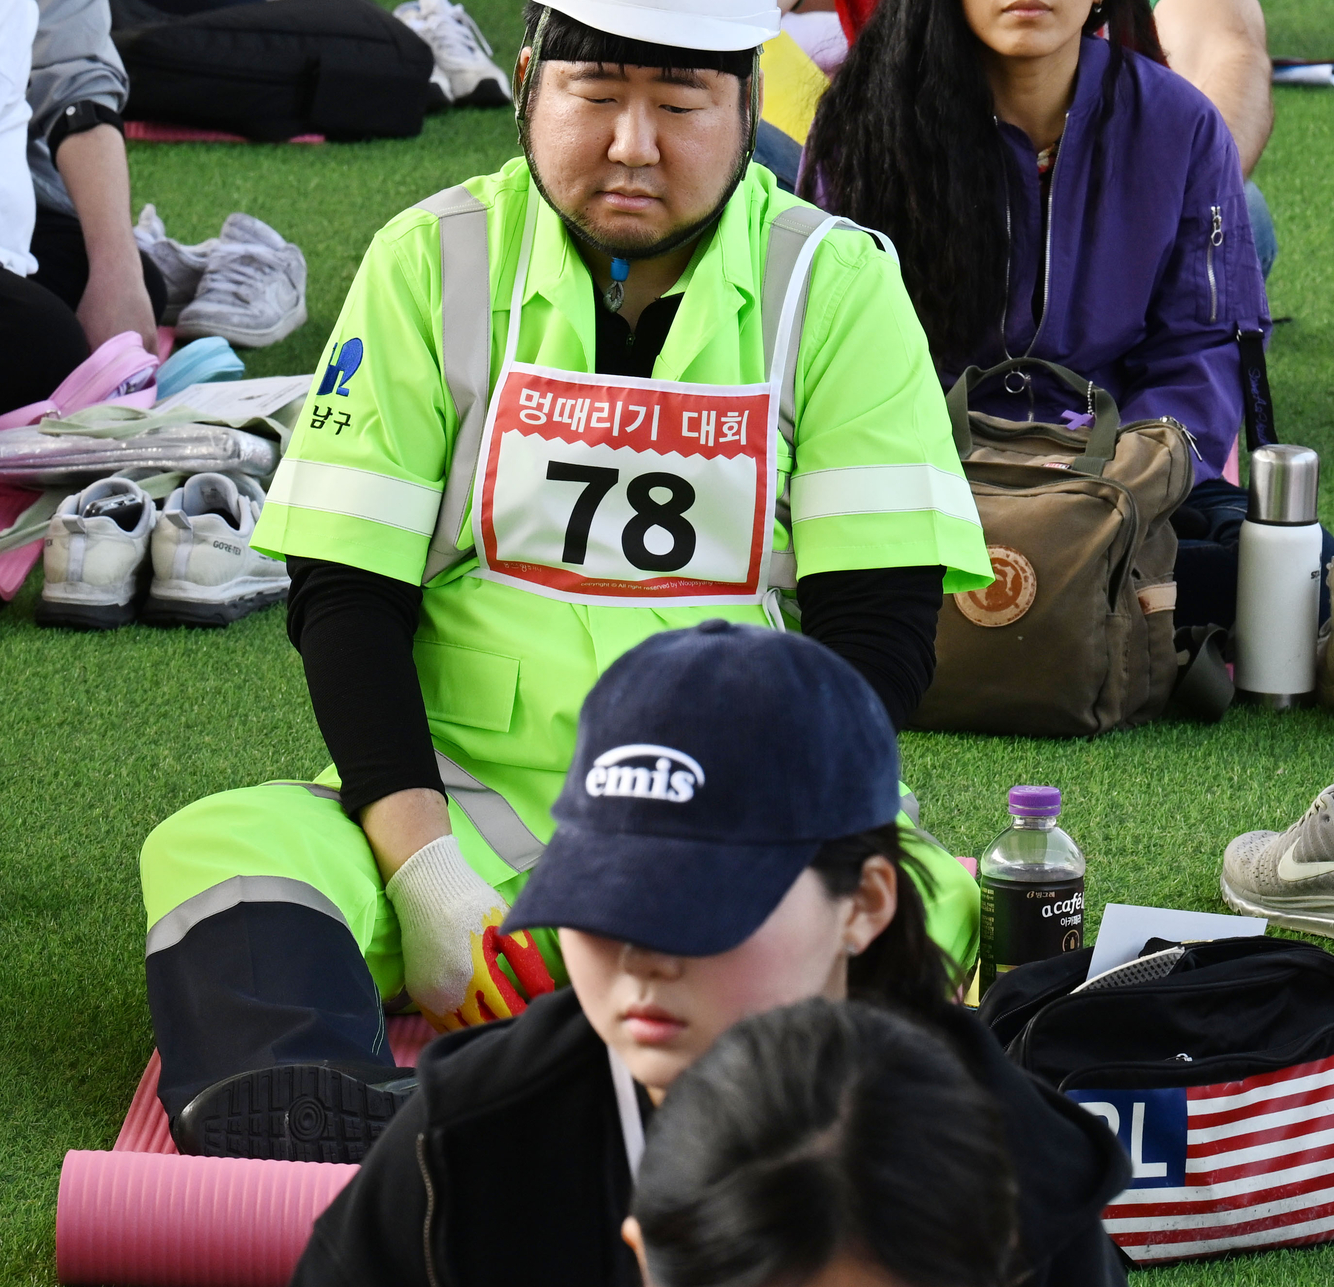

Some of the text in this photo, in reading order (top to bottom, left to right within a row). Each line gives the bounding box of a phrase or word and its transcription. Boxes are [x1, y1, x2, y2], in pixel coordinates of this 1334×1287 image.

[310, 405, 351, 435] 남구
[519, 387, 750, 447] 멍때리기 대회
[545, 459, 697, 573] 78
[212, 540, 242, 556] GORE-TEX
[643, 582, 670, 592] reserved
[670, 580, 678, 590] by
[585, 756, 696, 803] emis
